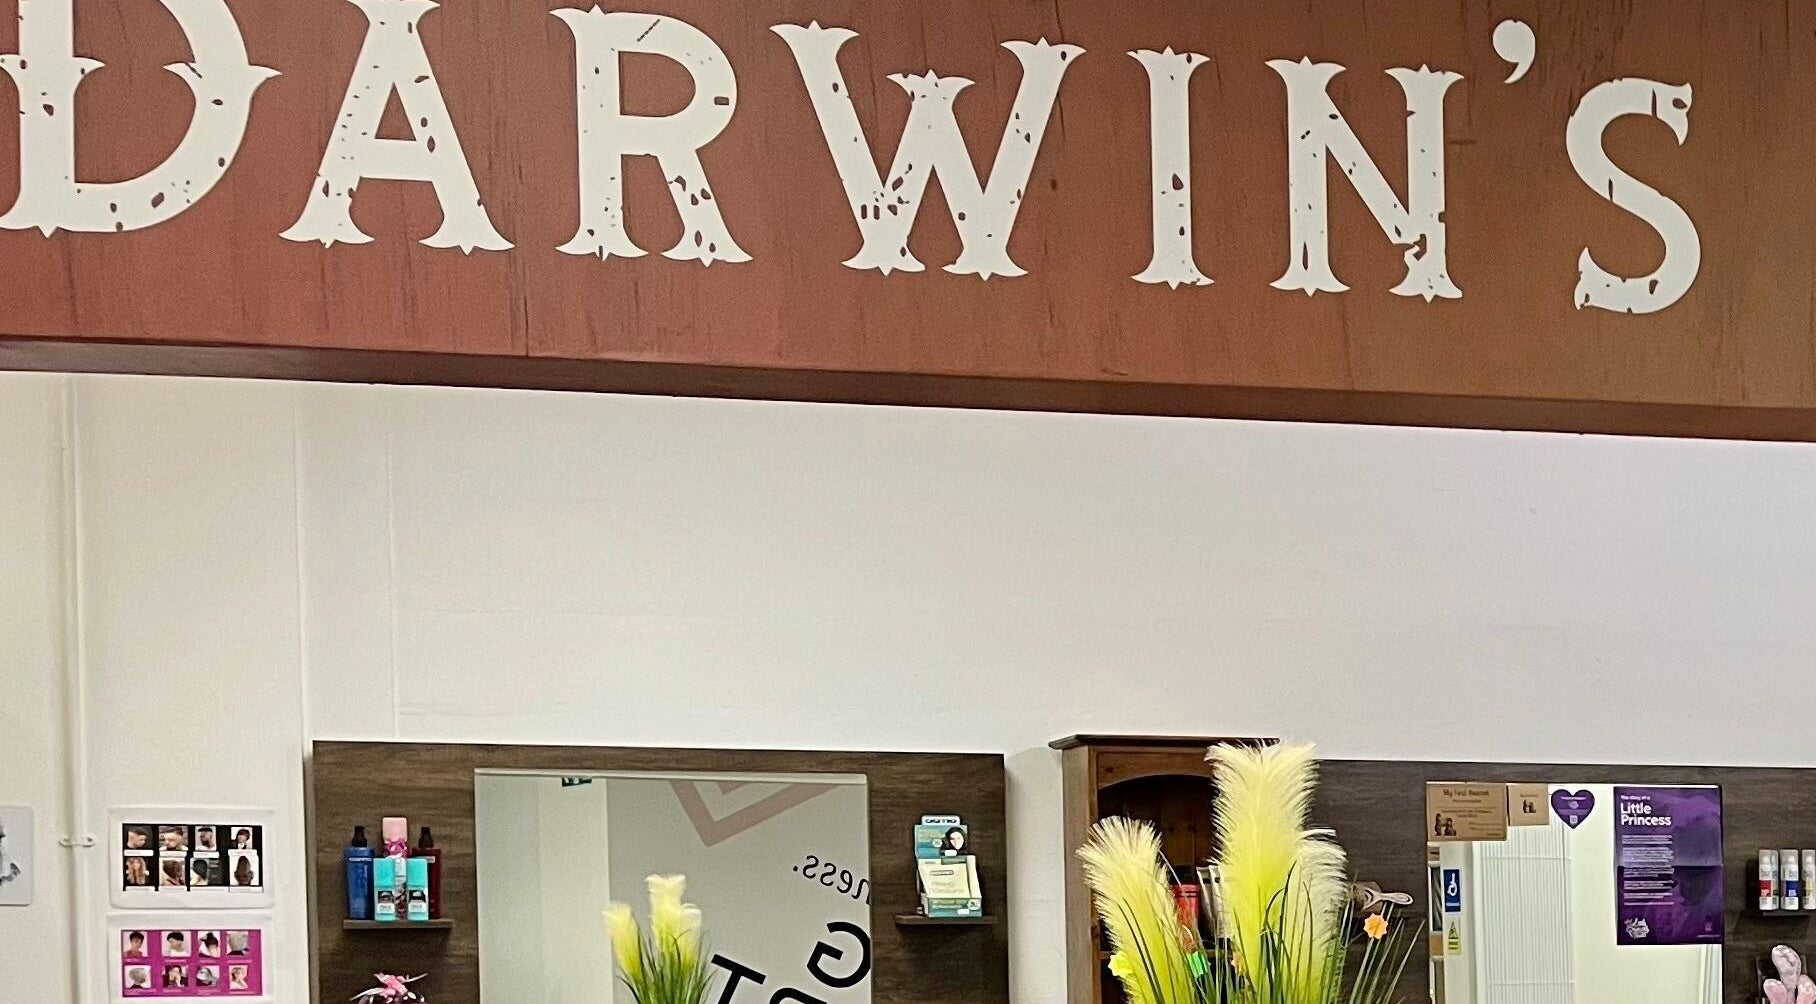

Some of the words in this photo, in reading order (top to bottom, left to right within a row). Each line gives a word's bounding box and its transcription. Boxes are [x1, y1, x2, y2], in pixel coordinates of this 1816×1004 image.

[0, 0, 1702, 314] DARWIN'S
[1620, 801, 1652, 815] Little
[1620, 813, 1672, 826] Princess
